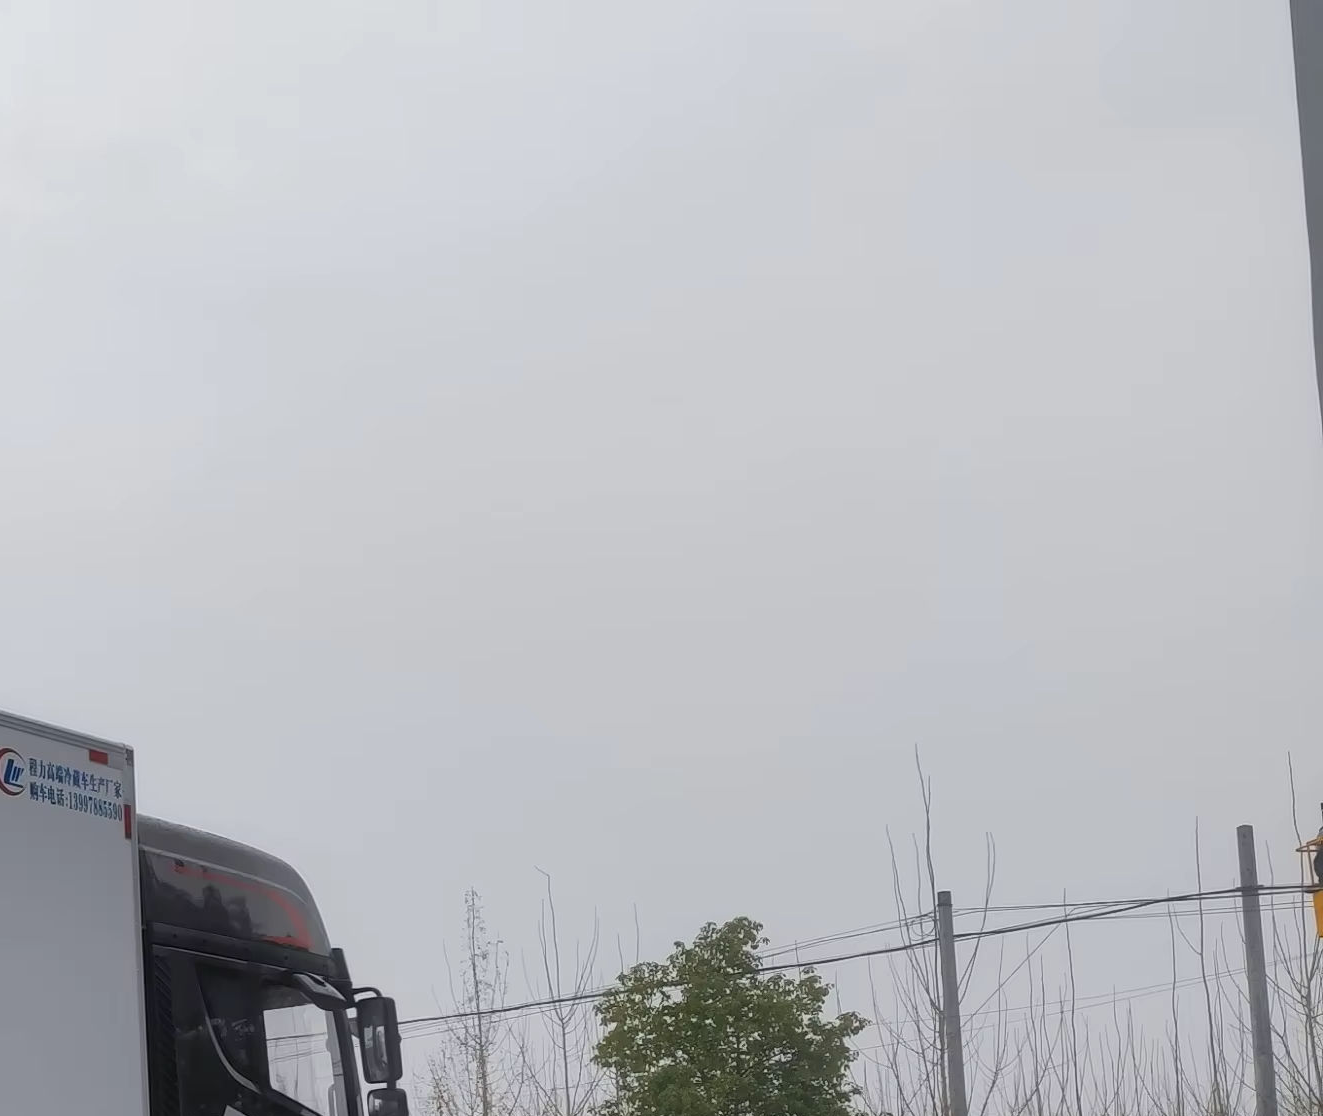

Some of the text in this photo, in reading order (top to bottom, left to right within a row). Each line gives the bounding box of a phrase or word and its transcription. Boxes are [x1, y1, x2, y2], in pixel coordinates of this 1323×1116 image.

[28, 757, 123, 800] 程力高端冷藏车生产厂家
